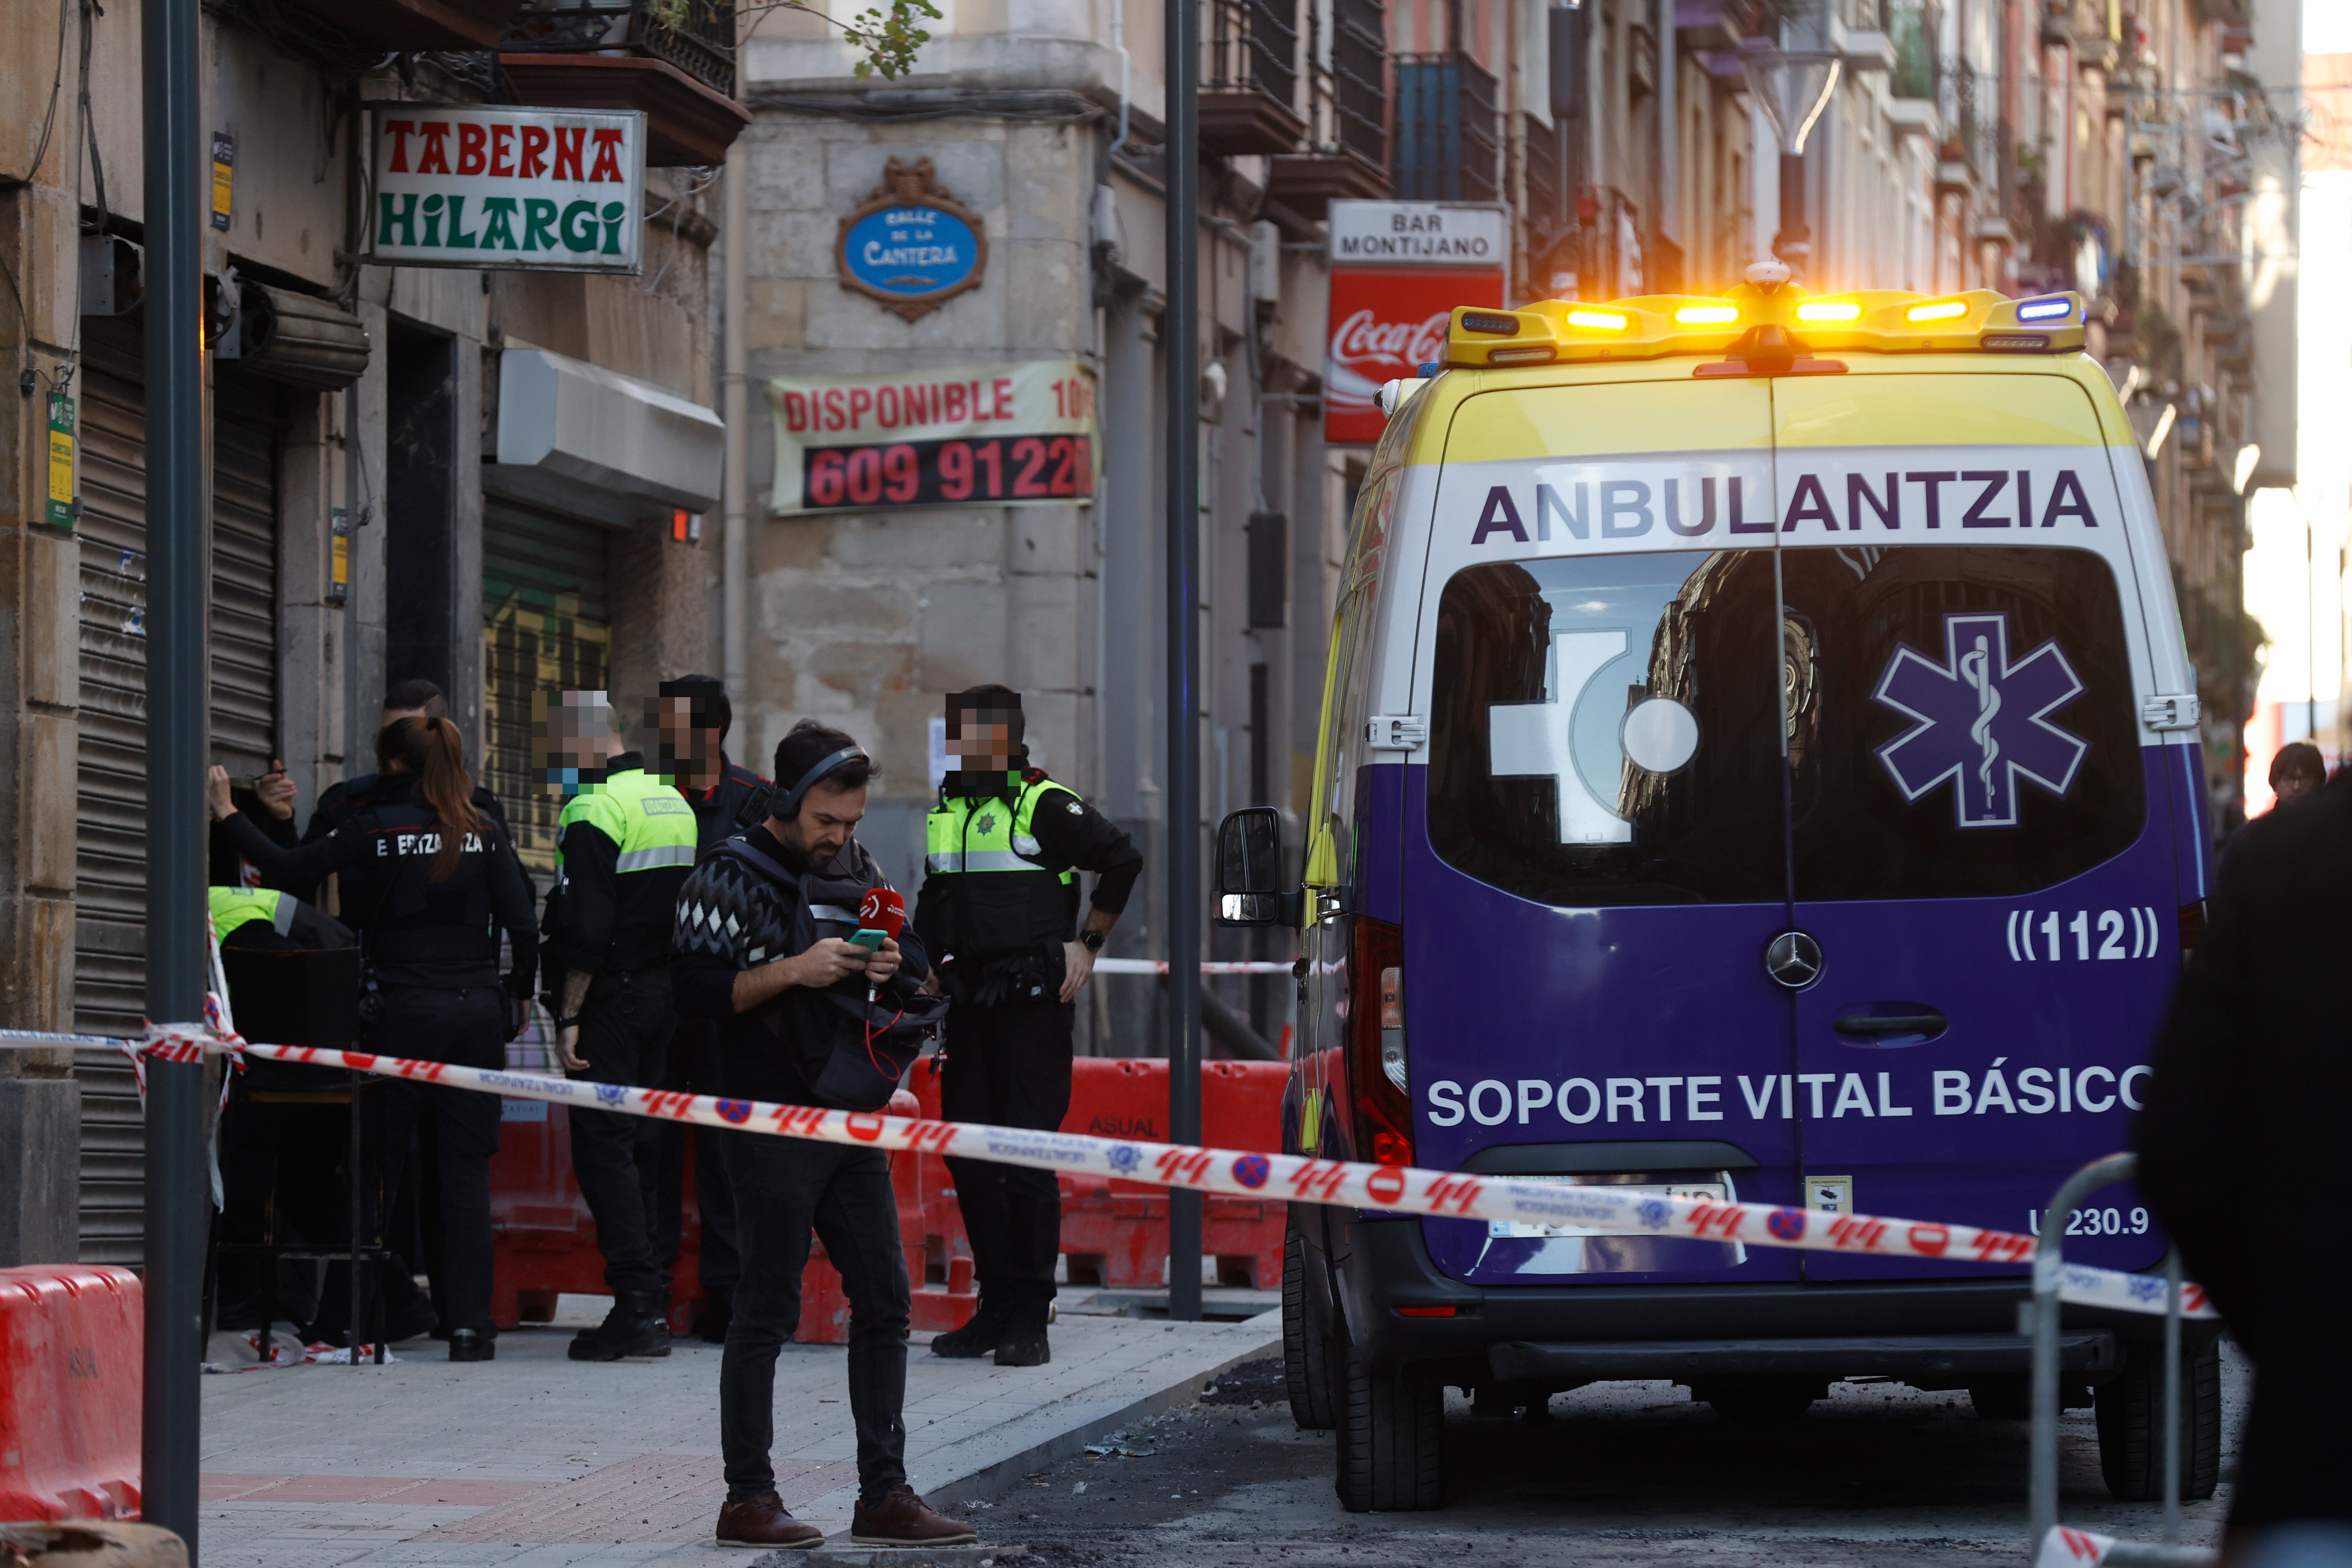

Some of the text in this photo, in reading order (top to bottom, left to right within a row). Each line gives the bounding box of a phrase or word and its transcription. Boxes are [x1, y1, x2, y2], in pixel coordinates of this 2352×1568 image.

[385, 120, 624, 182] TABERNA
[885, 211, 936, 227] CALLE
[890, 229, 934, 243] DE LA
[1392, 214, 1442, 232] BAR
[1341, 235, 1489, 255] MONTIJANO
[783, 379, 1014, 433] DISPONIBLE
[809, 443, 920, 506] 609
[1470, 469, 2099, 545] ANBULANTZIA
[1427, 1077, 1724, 1127] SOPORTE
[1737, 1072, 1913, 1120] VITAL
[1089, 1115, 1159, 1138] ASUAL
